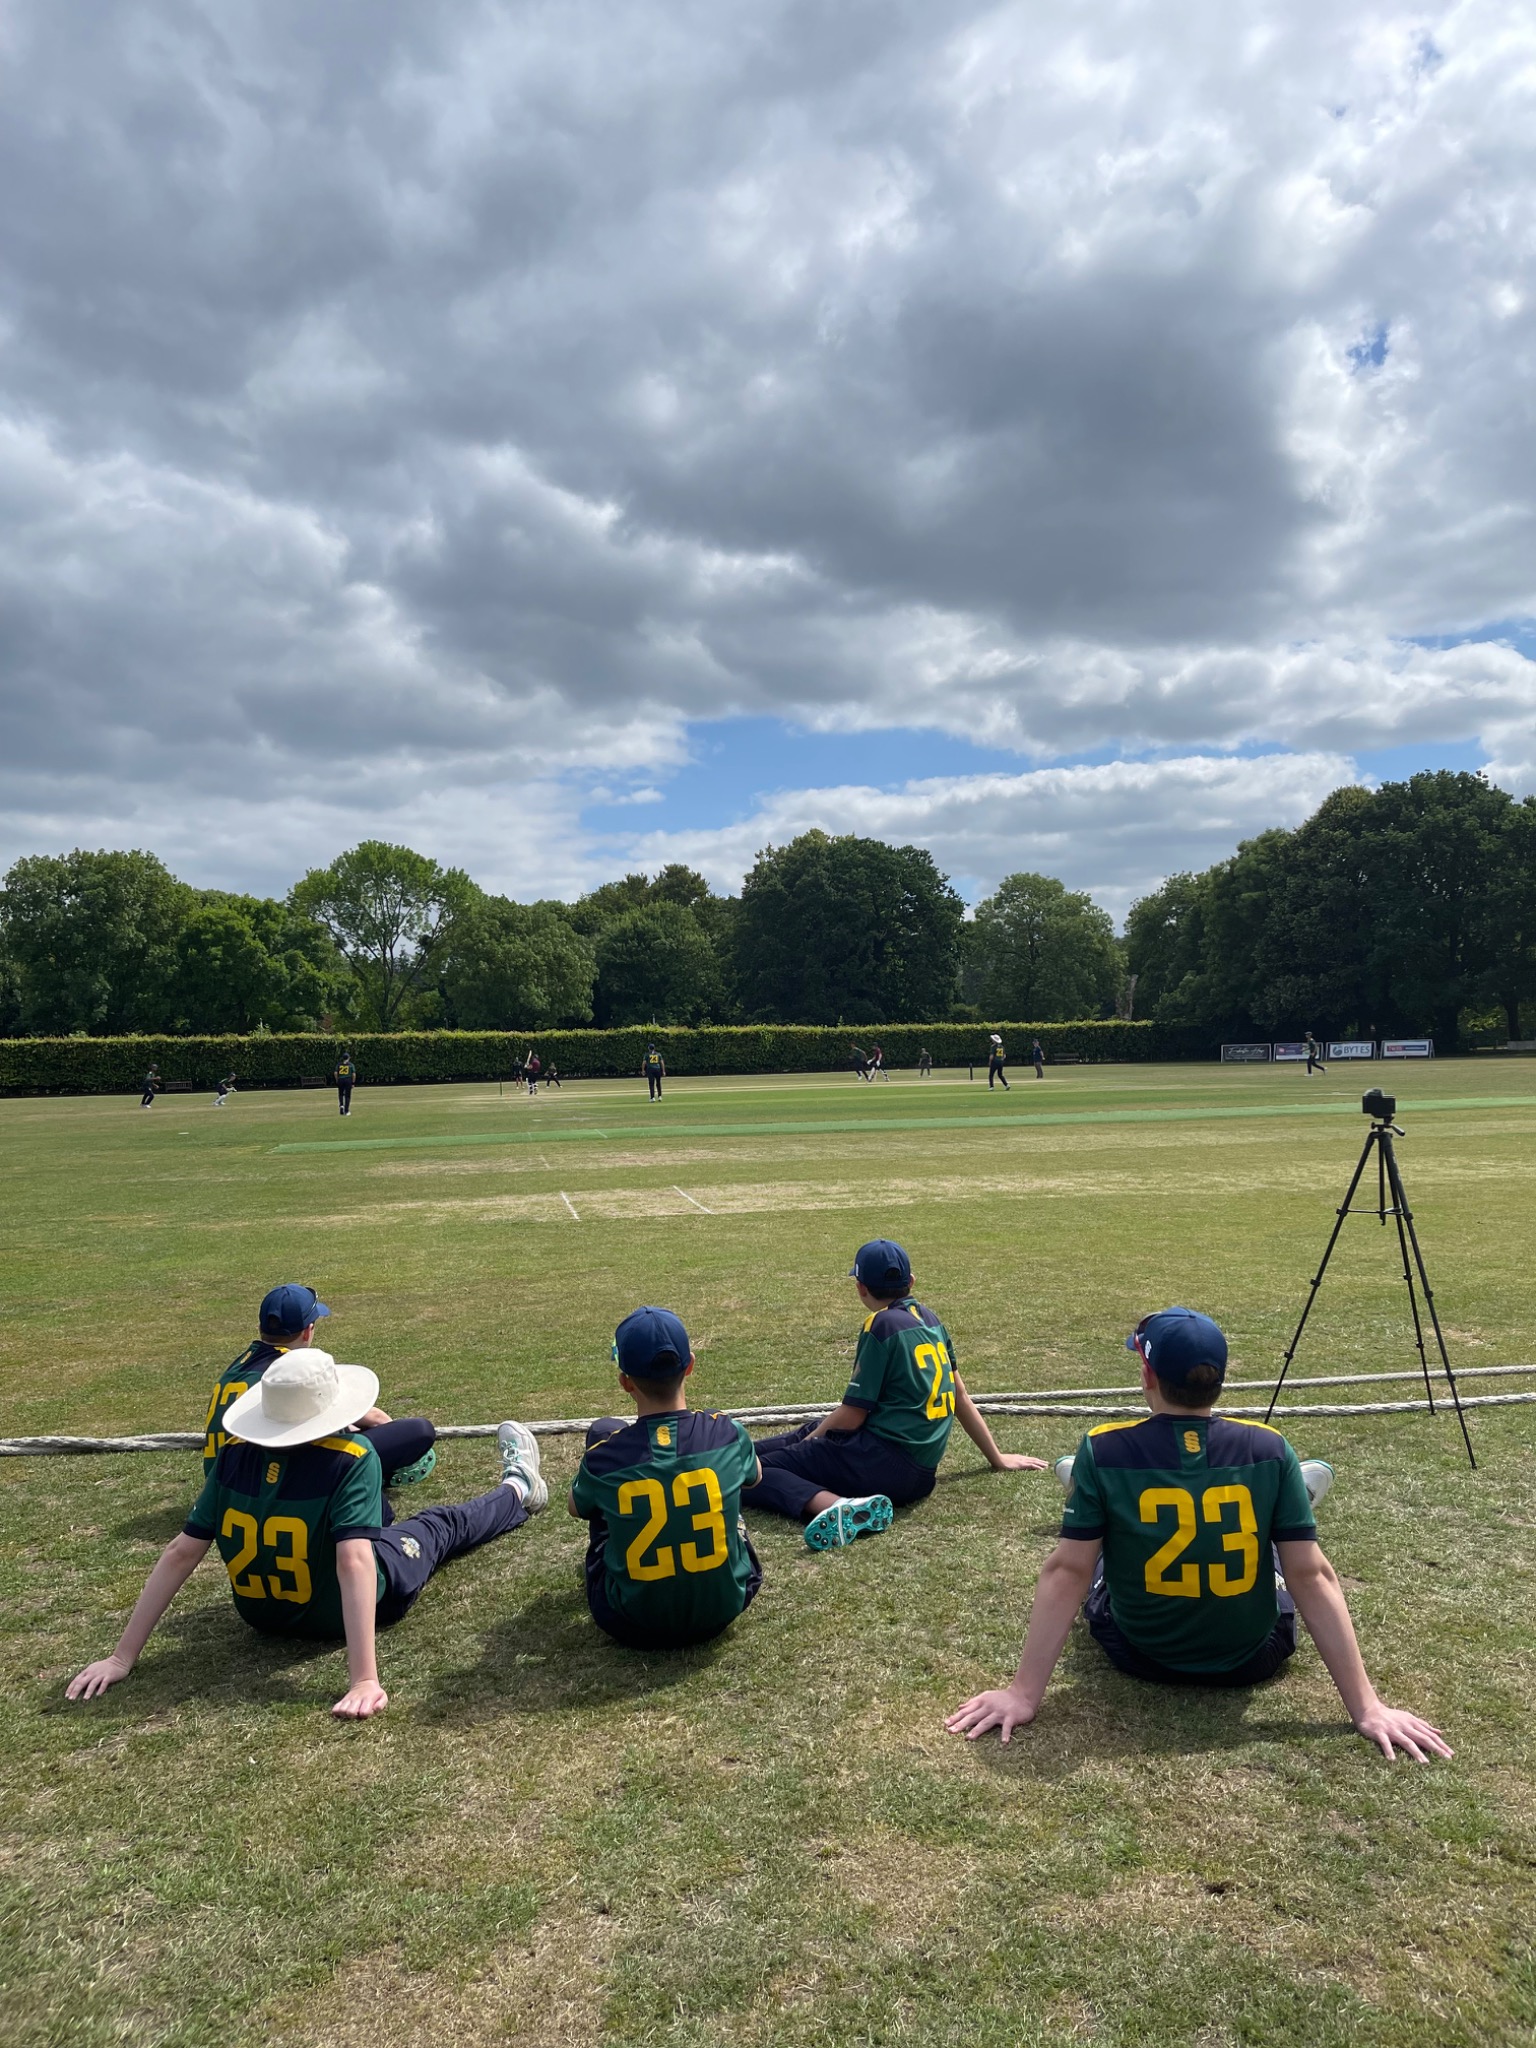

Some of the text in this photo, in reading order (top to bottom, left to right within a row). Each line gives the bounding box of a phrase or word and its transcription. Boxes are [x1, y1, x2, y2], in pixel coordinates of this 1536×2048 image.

[339, 1065, 349, 1075] 23
[649, 1055, 659, 1064] 23
[1344, 1046, 1370, 1054] BYTES
[618, 1467, 729, 1582] 23
[1139, 1484, 1259, 1598] 23
[221, 1507, 312, 1605] 23
